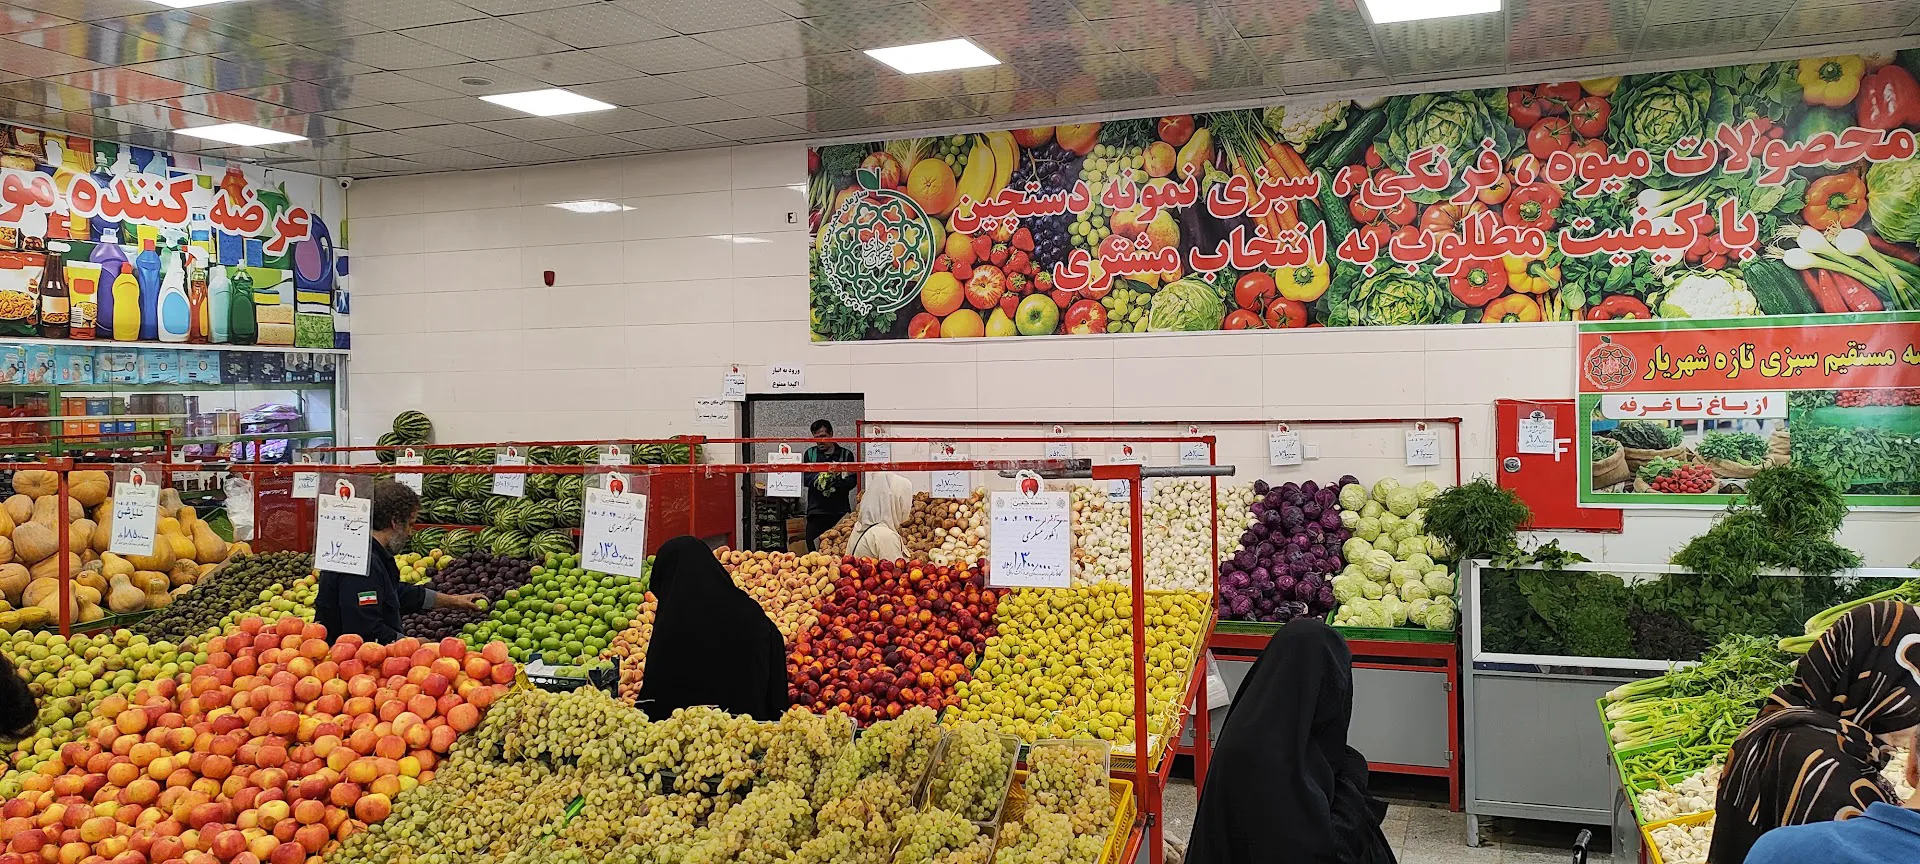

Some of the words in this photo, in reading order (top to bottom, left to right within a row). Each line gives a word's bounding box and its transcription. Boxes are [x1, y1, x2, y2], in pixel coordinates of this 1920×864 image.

[1361, 138, 1502, 209] فرنگی
[1546, 149, 1650, 197] میوه
[1666, 121, 1914, 186] محصولات
[71, 176, 193, 223] کننده
[842, 190, 869, 212] سازمان
[952, 180, 1091, 233] دستچین
[1102, 161, 1197, 222] نمونه
[1208, 165, 1320, 218] سبزی
[209, 188, 311, 252] عرضه
[1389, 212, 1544, 277] مطلوب
[1558, 200, 1706, 267] کیفیت
[1719, 200, 1758, 263] با
[1053, 236, 1180, 291] مشتری
[1192, 221, 1326, 283] انتخاب
[1337, 227, 1379, 278] به
[1643, 344, 1710, 380] شهریار
[1715, 342, 1755, 378] تازه
[1760, 350, 1819, 377] سبزی
[1823, 340, 1896, 377] مستقیم
[1619, 396, 1673, 416] غرفه
[1676, 396, 1703, 411] تا
[1706, 395, 1748, 416] باغ
[1752, 396, 1768, 415] از
